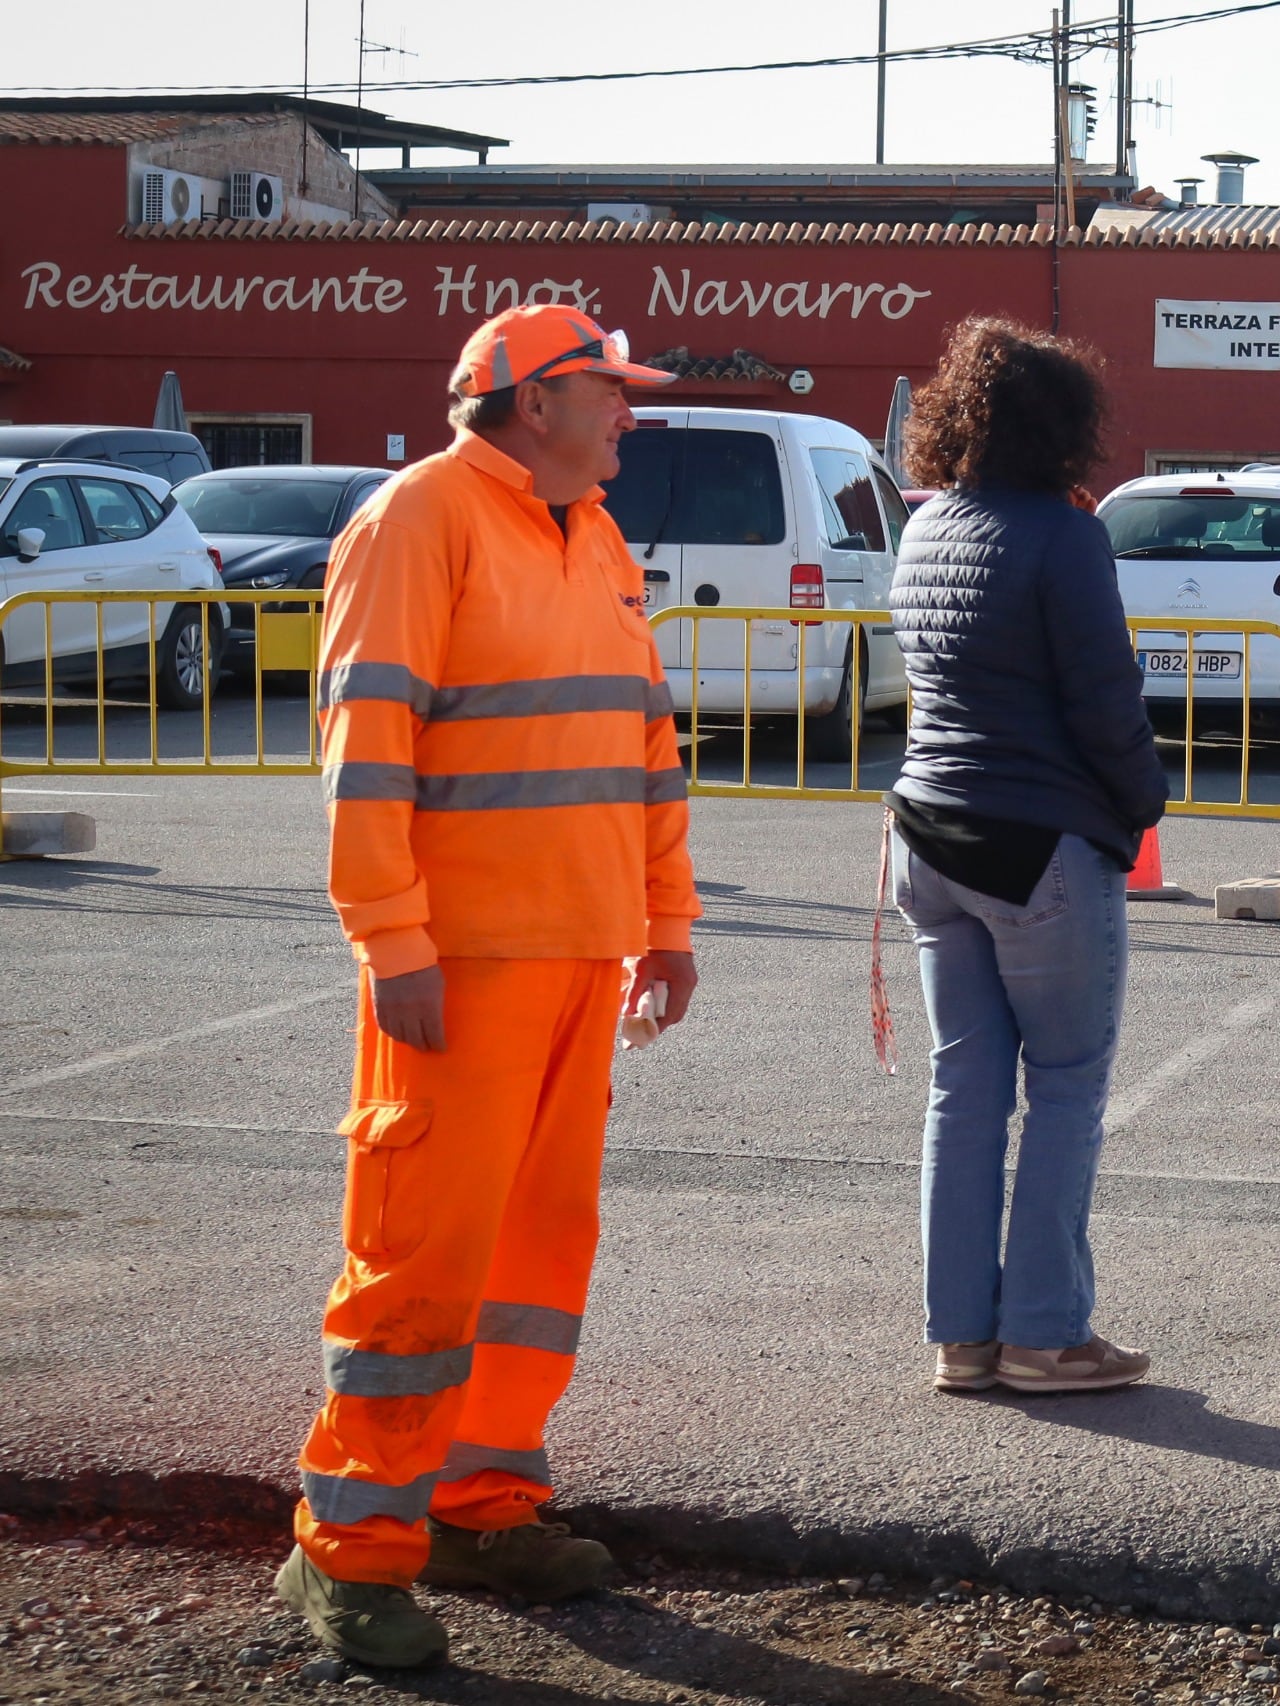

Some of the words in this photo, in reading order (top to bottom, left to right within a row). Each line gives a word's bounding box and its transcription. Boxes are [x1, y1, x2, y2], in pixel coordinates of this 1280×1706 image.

[21, 261, 408, 314] Restaurante
[433, 264, 602, 316] Hnos.
[647, 265, 932, 320] Navarro
[1161, 312, 1262, 330] TERRAZA
[1198, 655, 1231, 673] HBP
